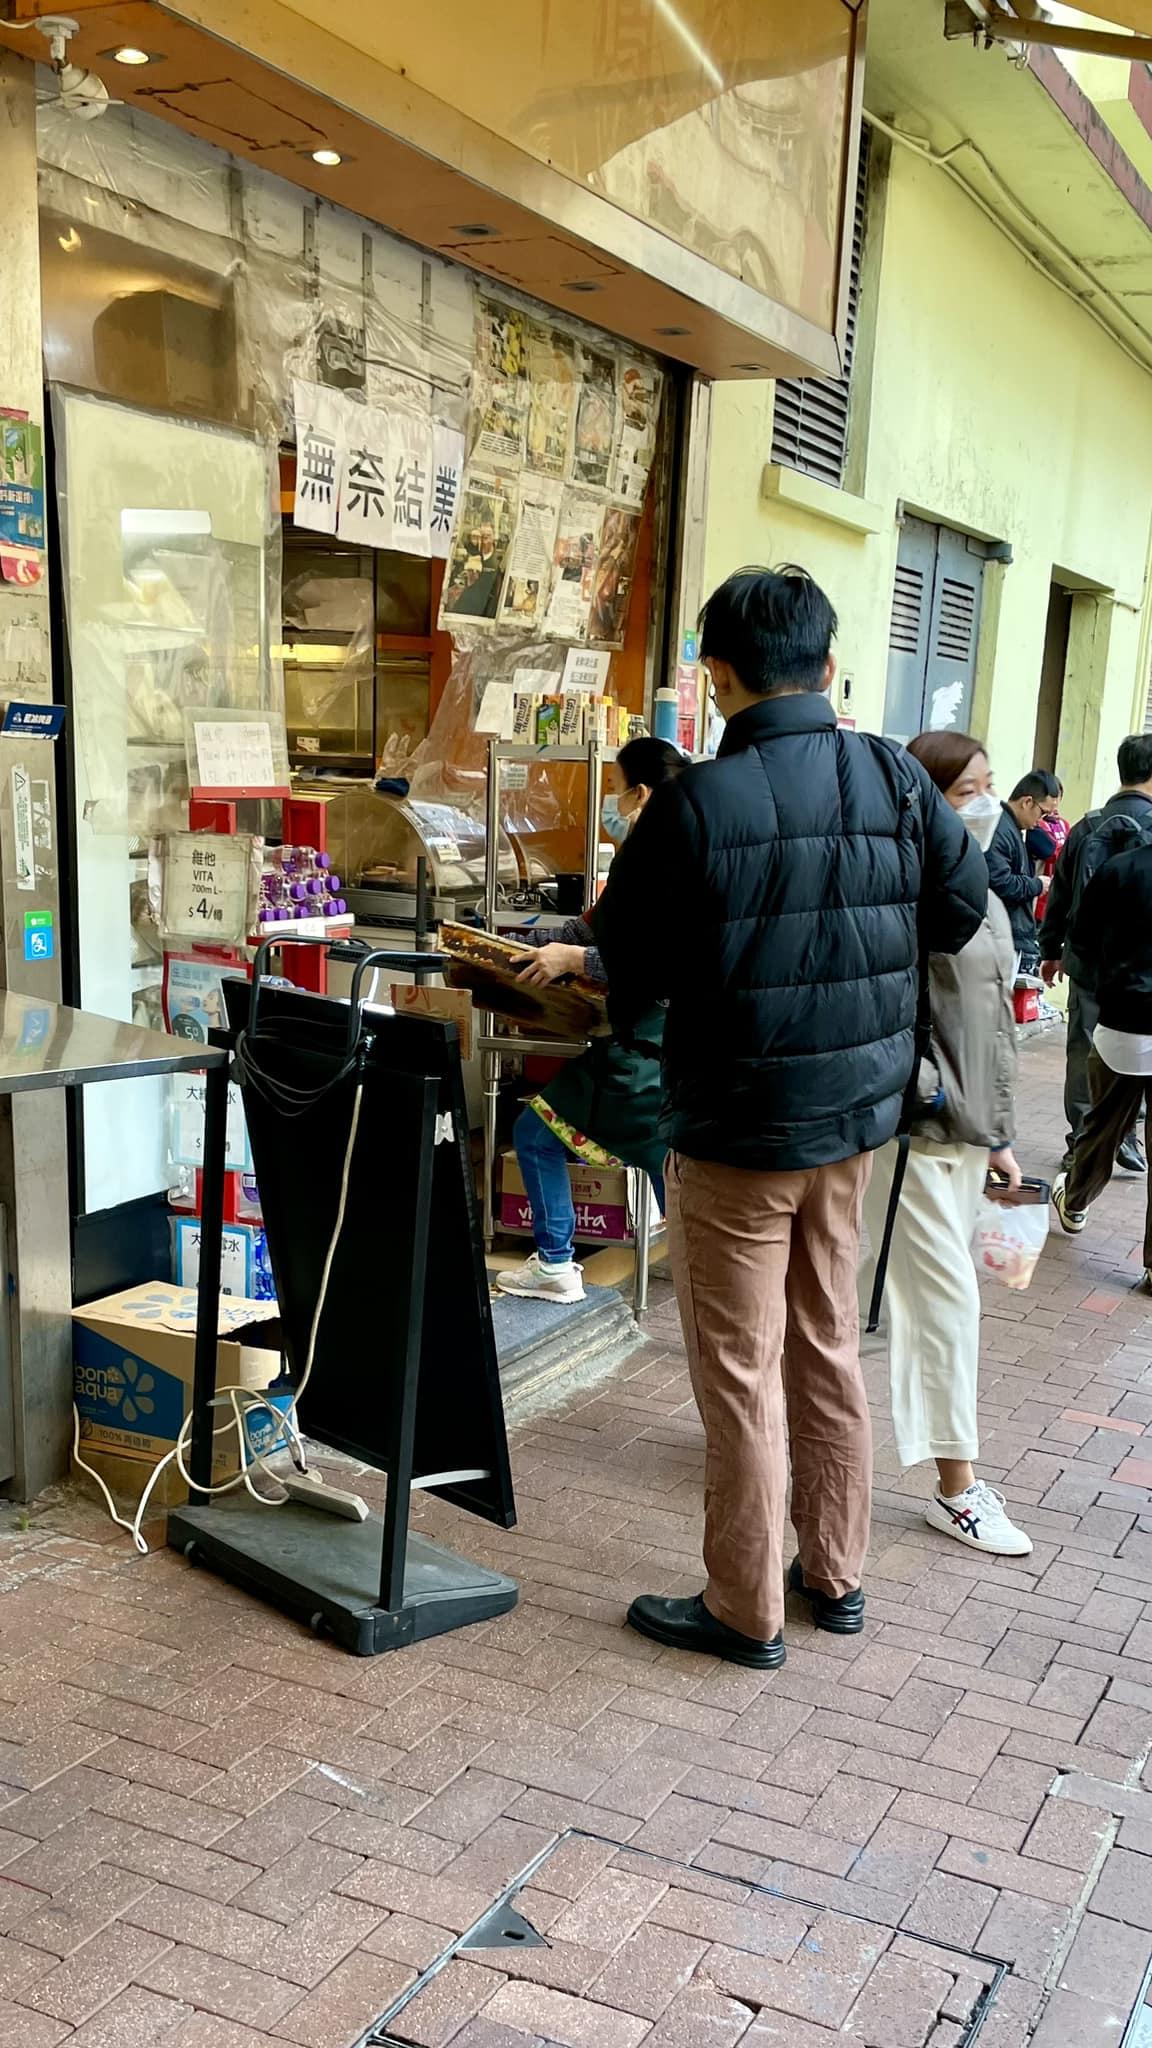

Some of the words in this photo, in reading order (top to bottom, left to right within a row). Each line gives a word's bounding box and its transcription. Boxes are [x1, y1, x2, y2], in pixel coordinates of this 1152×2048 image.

[300, 424, 457, 532] 無奈結業
[192, 849, 216, 867] 維他
[193, 870, 214, 882] VITA
[75, 1380, 119, 1400] aqua
